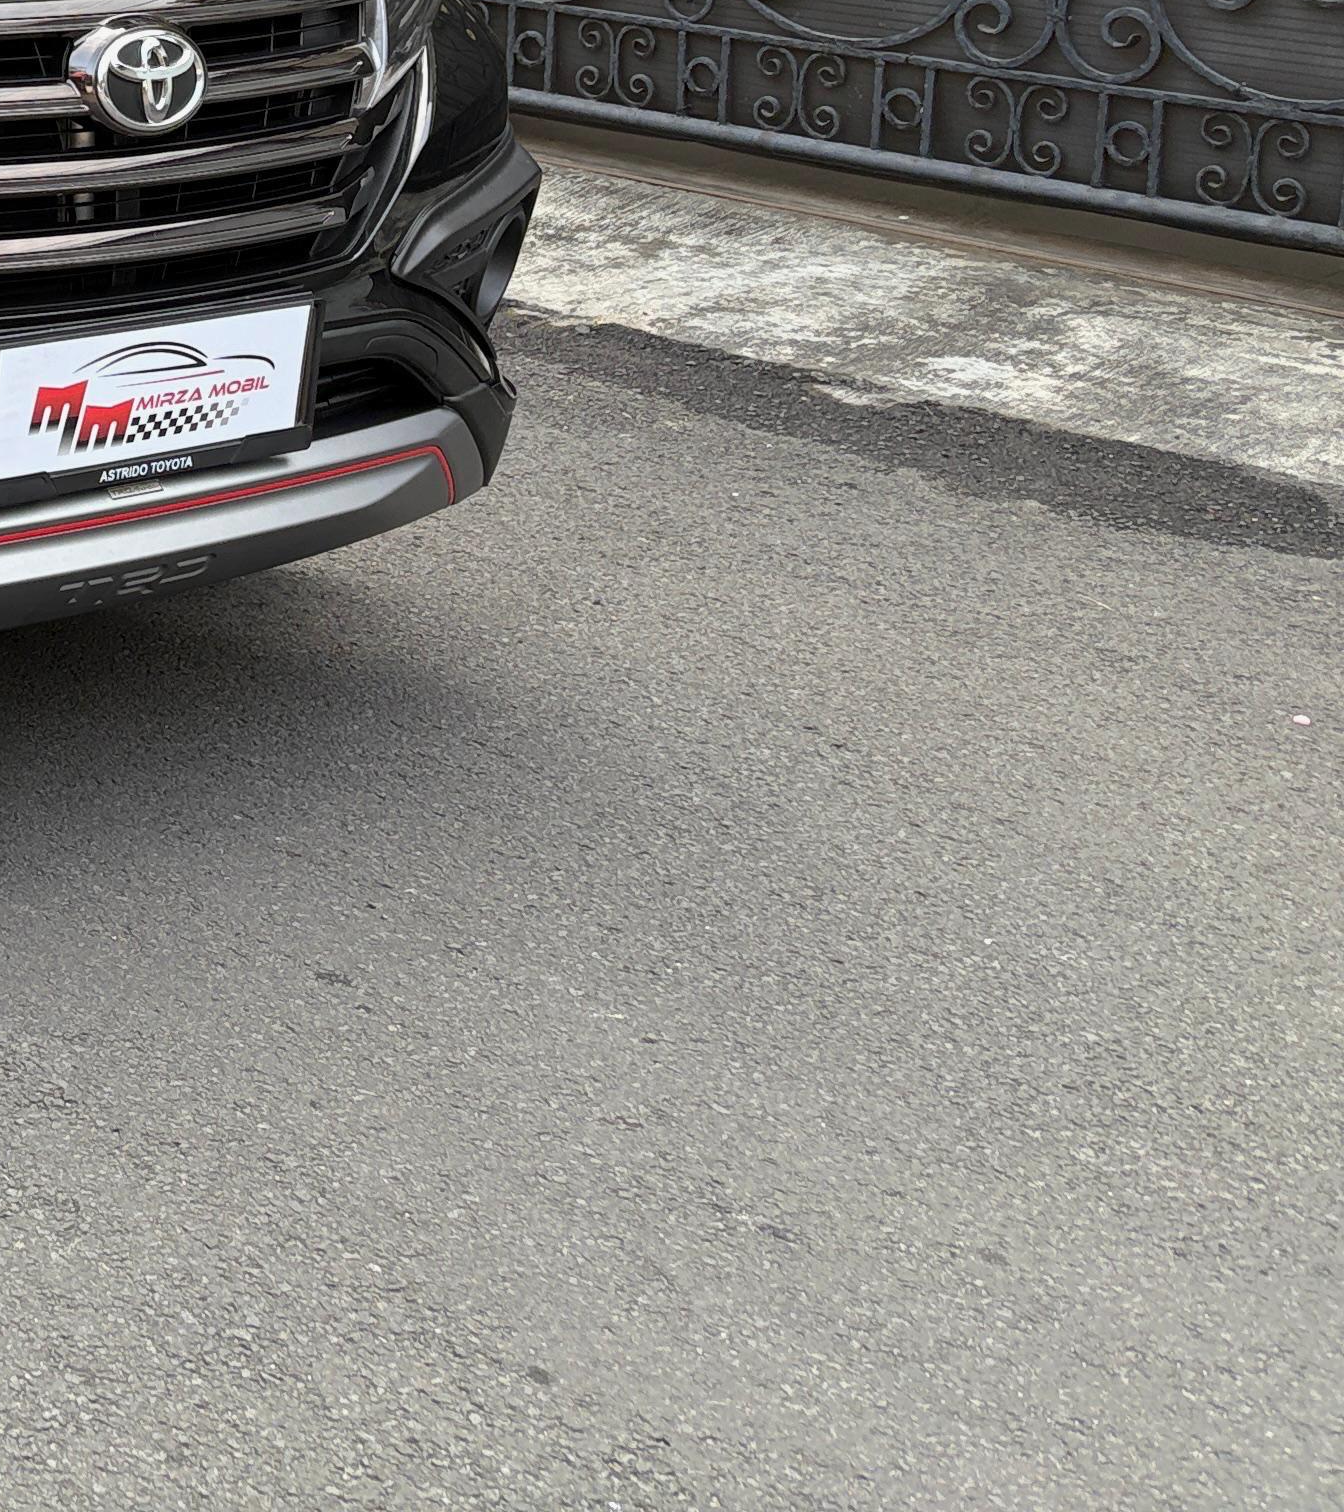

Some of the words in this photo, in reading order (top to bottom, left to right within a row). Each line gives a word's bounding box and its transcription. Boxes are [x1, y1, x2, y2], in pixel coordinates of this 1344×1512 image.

[136, 389, 203, 411] MIRZA
[208, 376, 269, 399] MOBIL
[99, 463, 148, 483] ASTRIDO
[150, 455, 193, 475] TOYOTA
